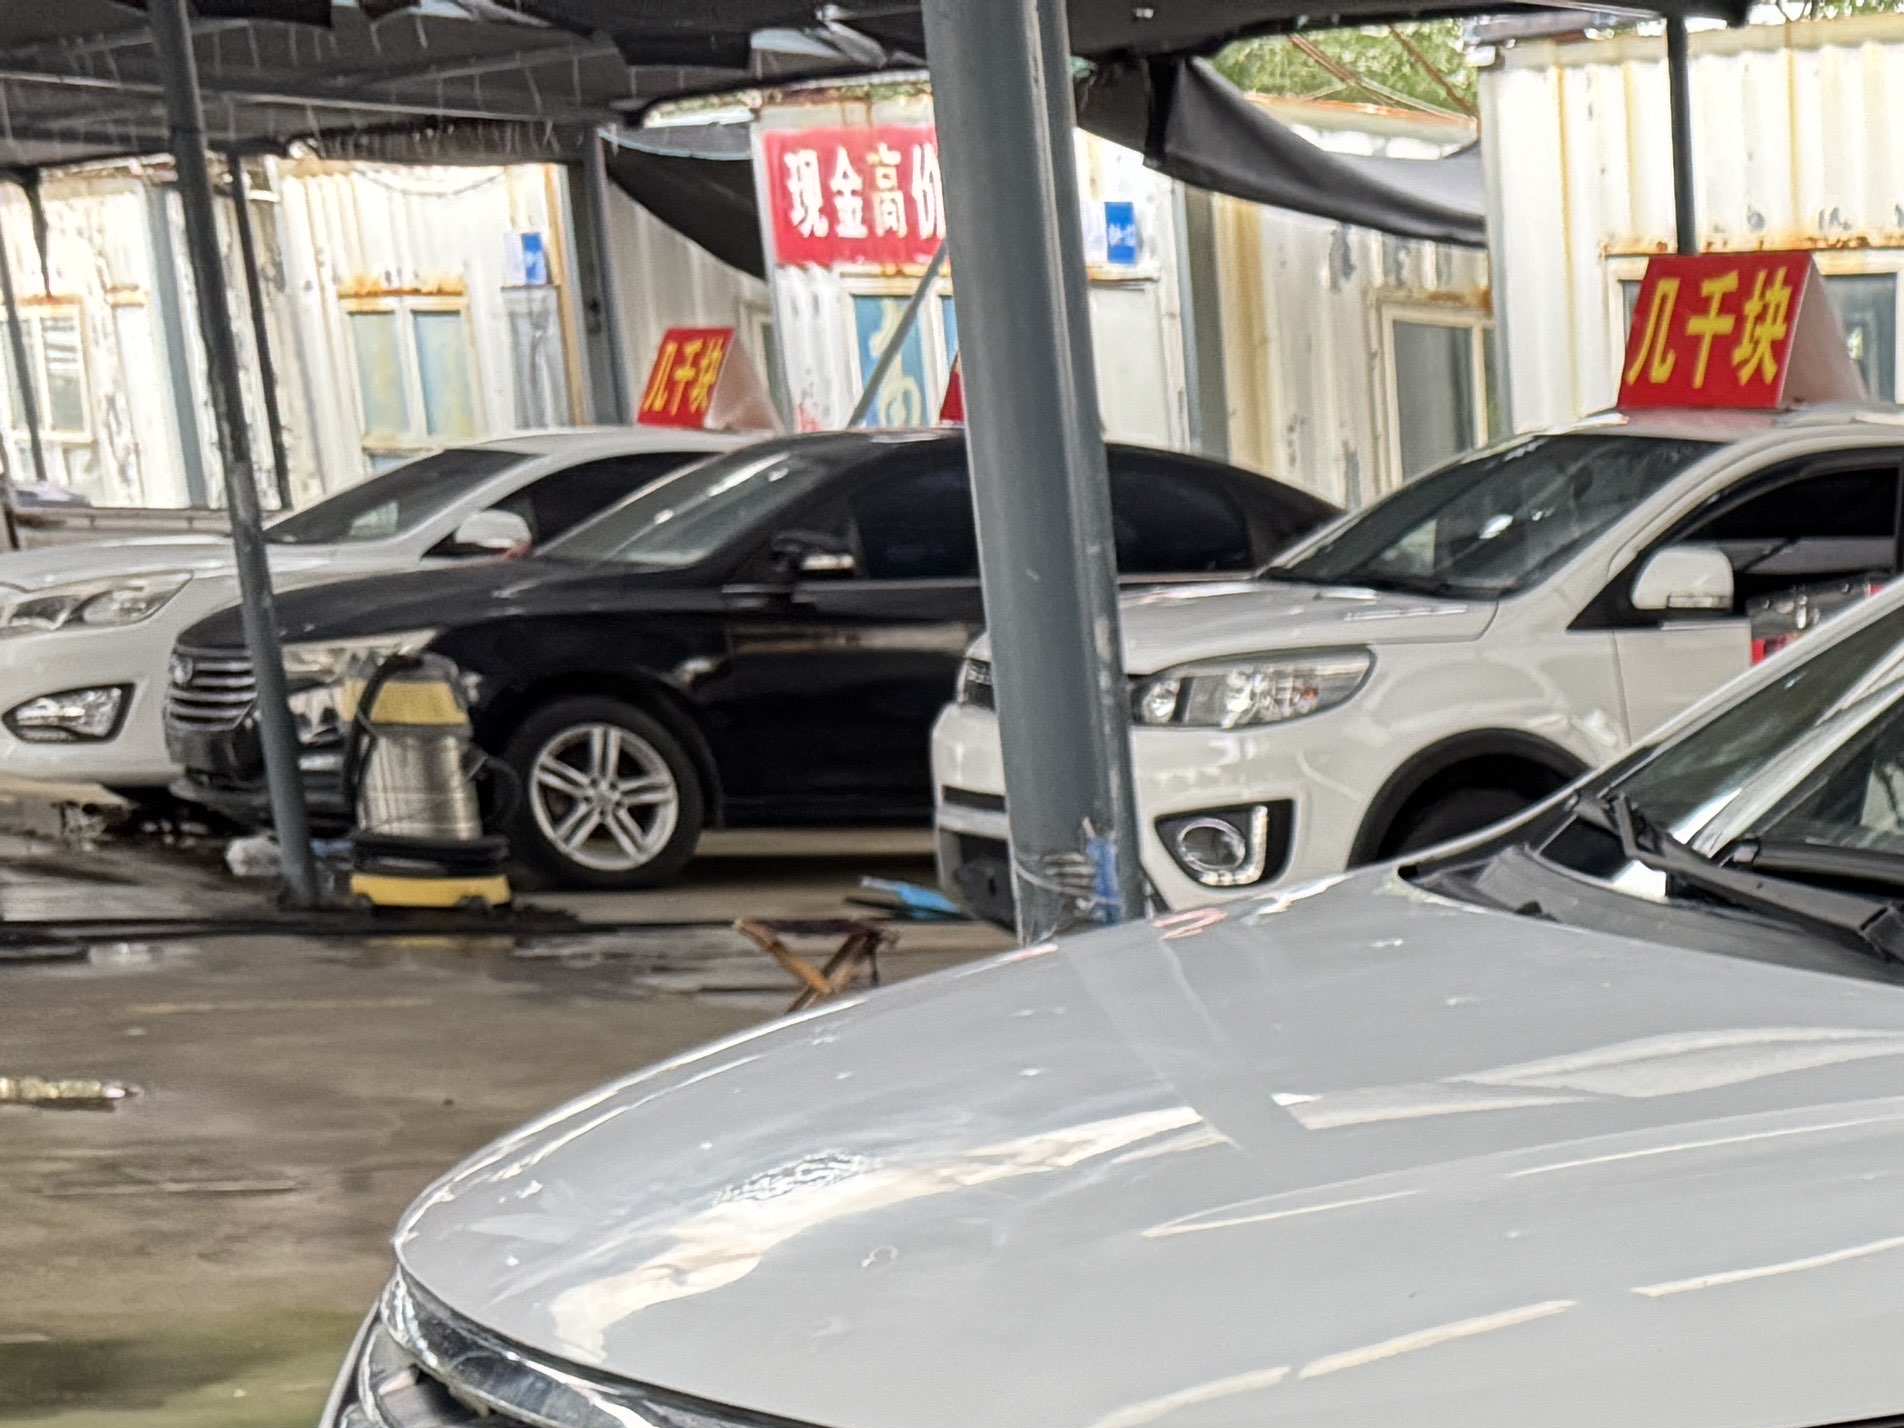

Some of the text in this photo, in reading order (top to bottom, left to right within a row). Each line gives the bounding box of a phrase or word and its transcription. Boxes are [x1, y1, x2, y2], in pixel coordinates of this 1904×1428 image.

[643, 337, 724, 418] 几千块
[1626, 266, 1792, 390] 几千块
